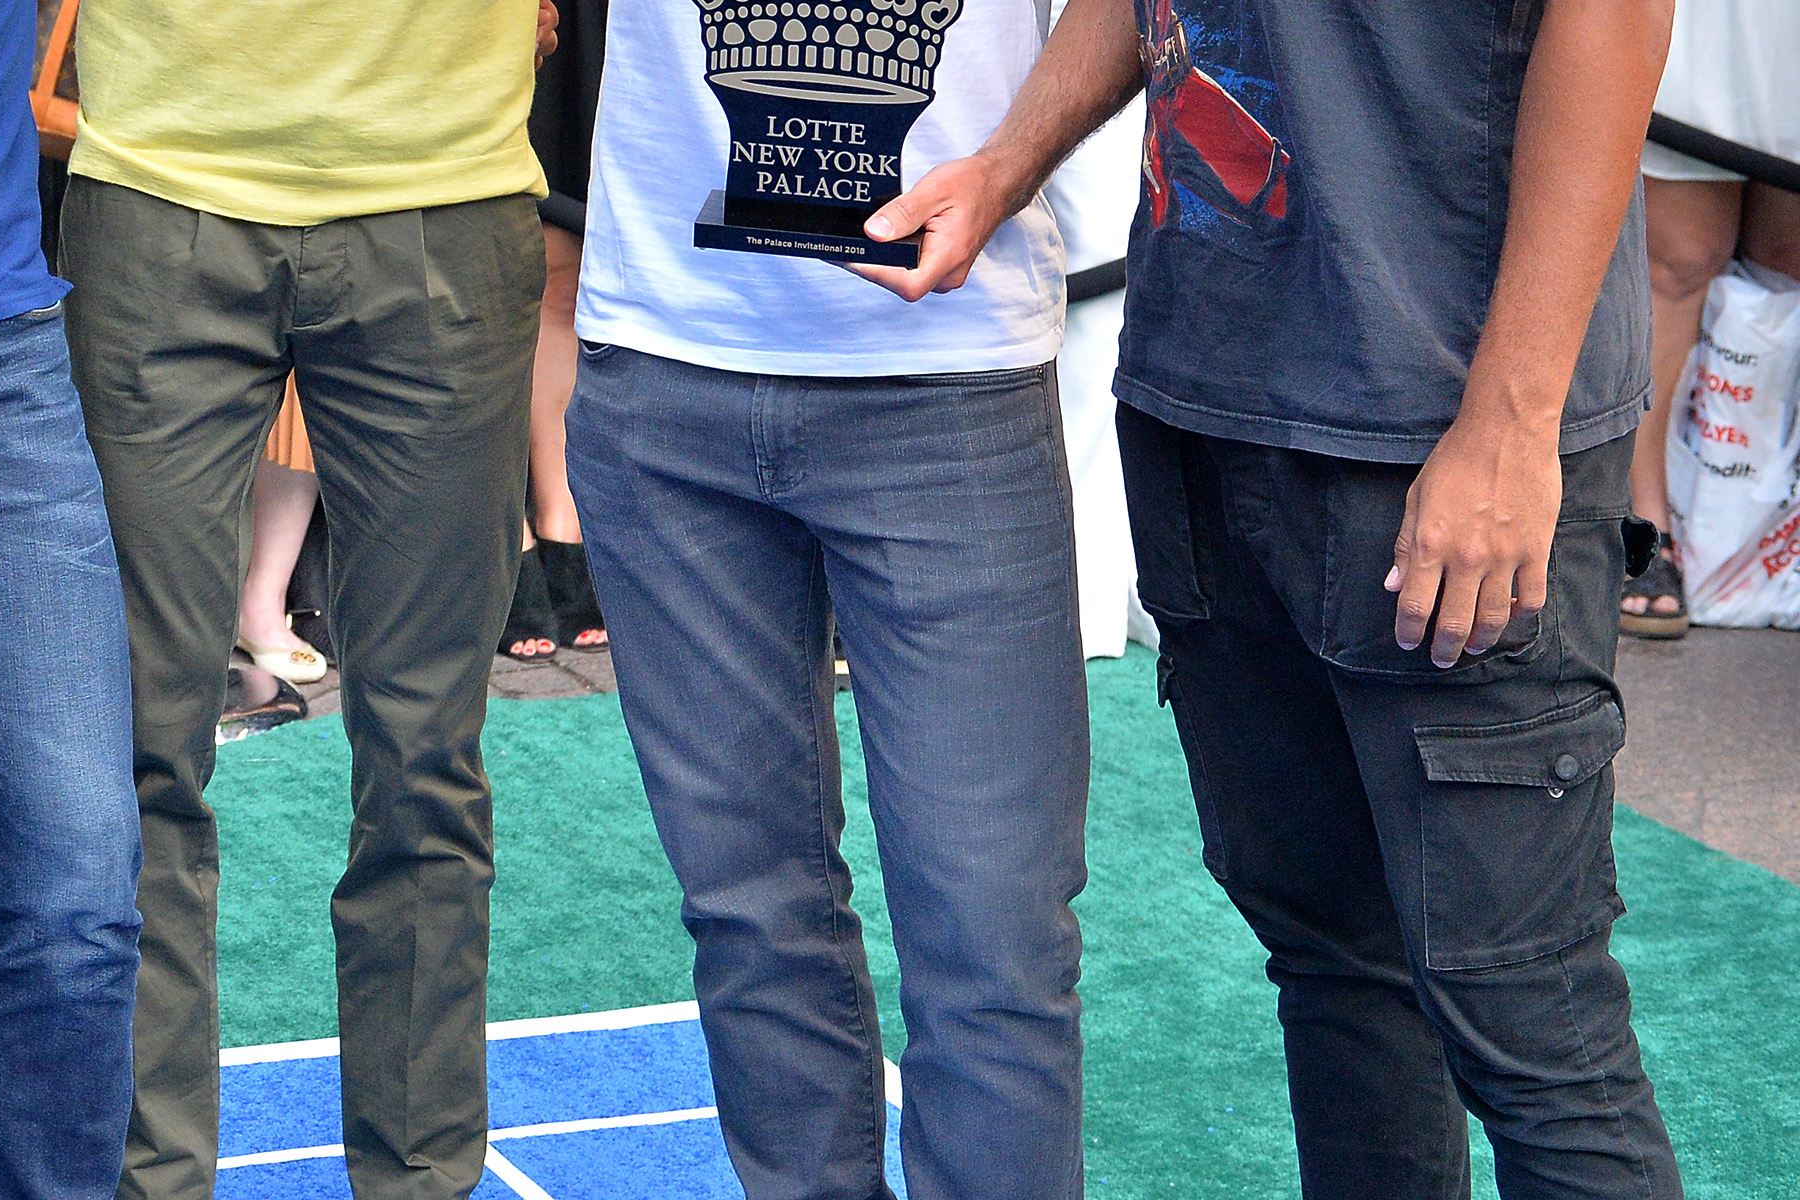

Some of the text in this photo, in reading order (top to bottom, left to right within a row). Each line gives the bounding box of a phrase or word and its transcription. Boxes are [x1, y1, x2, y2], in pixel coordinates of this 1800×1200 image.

[766, 116, 866, 145] LOTTE
[733, 141, 898, 177] NEW YORK
[756, 171, 871, 202] PALACE
[746, 236, 865, 255] The Palace Invitational 2018
